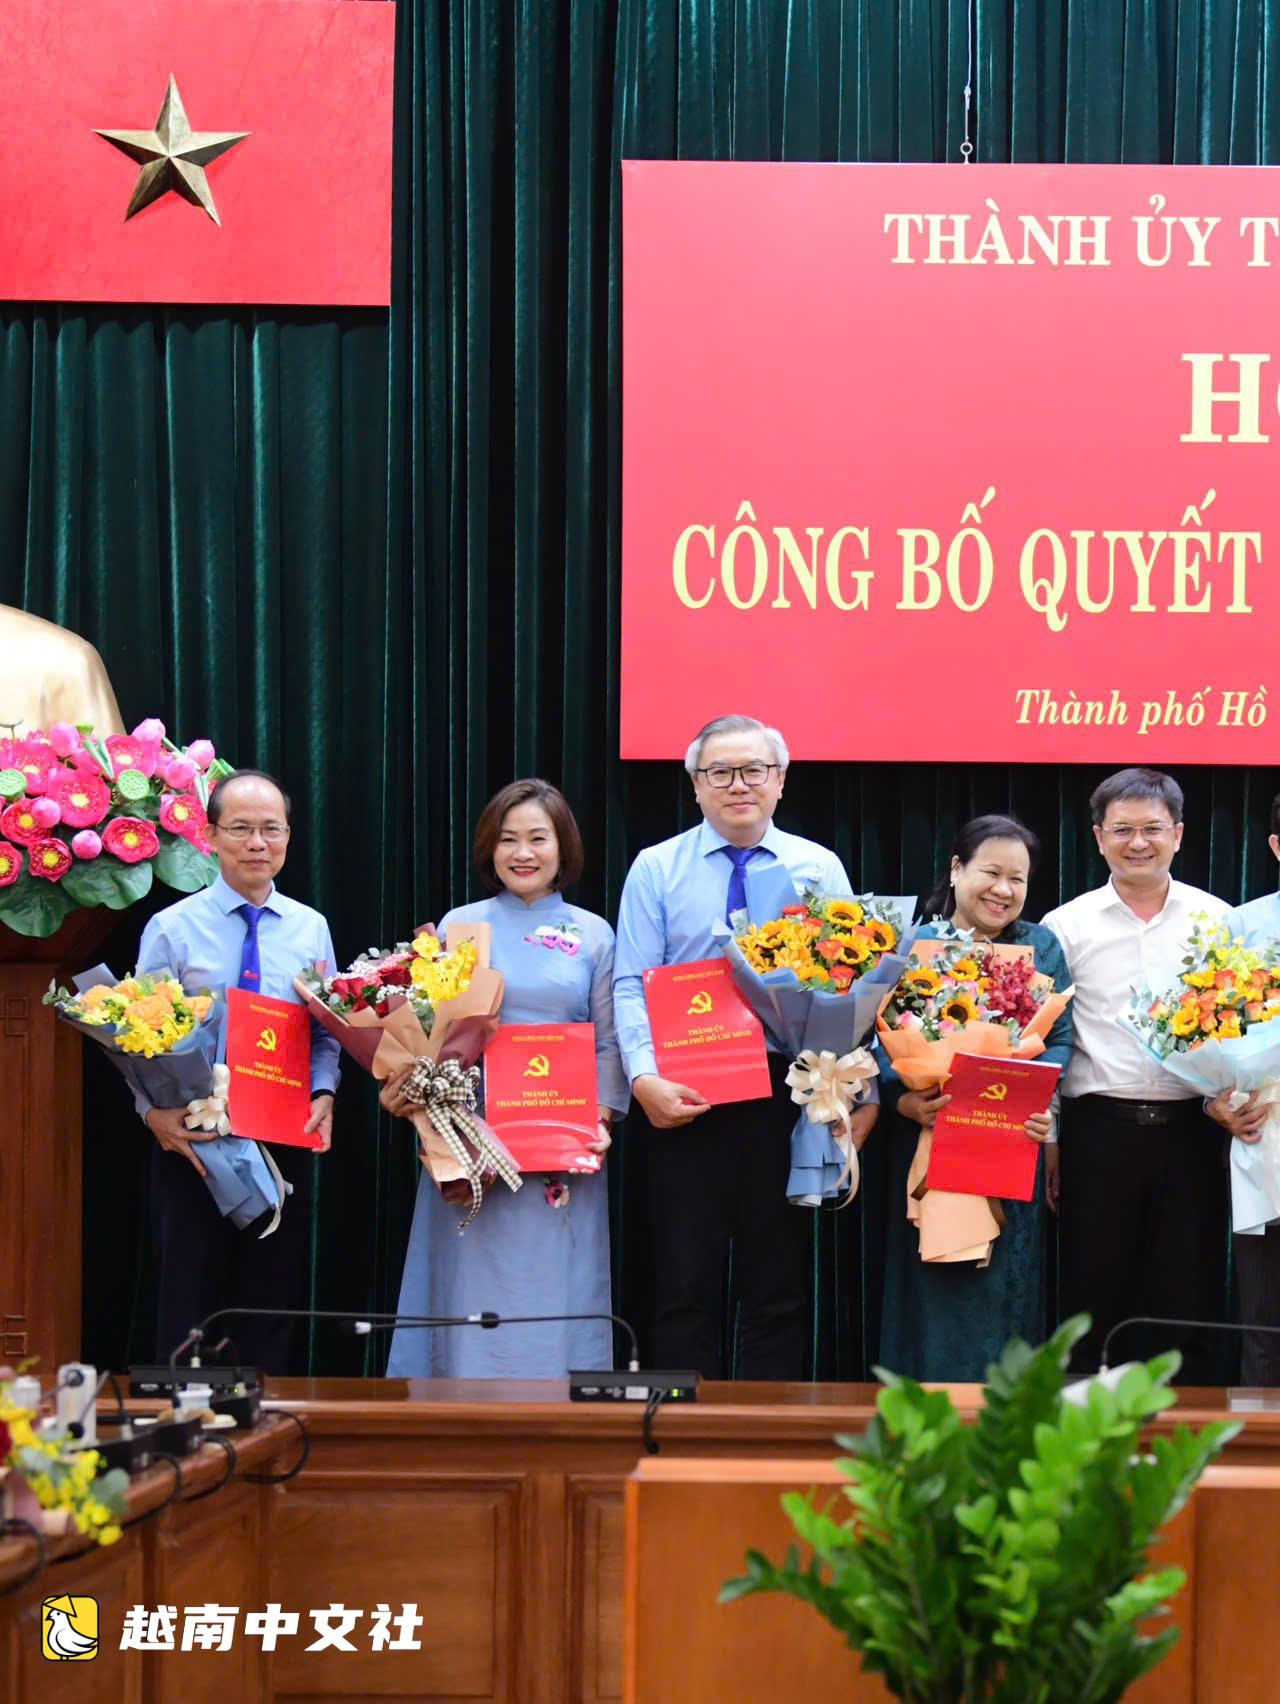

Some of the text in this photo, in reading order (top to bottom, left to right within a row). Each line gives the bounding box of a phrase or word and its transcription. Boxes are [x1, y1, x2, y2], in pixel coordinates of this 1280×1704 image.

[883, 197, 1112, 266] THÀNH
[1131, 193, 1222, 268] ỦY
[673, 500, 874, 611] CÔNG
[896, 486, 996, 612] BỐ
[1020, 488, 1262, 632] QUYẾT
[1016, 689, 1128, 725] Thành
[1137, 686, 1211, 734] phố
[1217, 685, 1267, 727] Hồ
